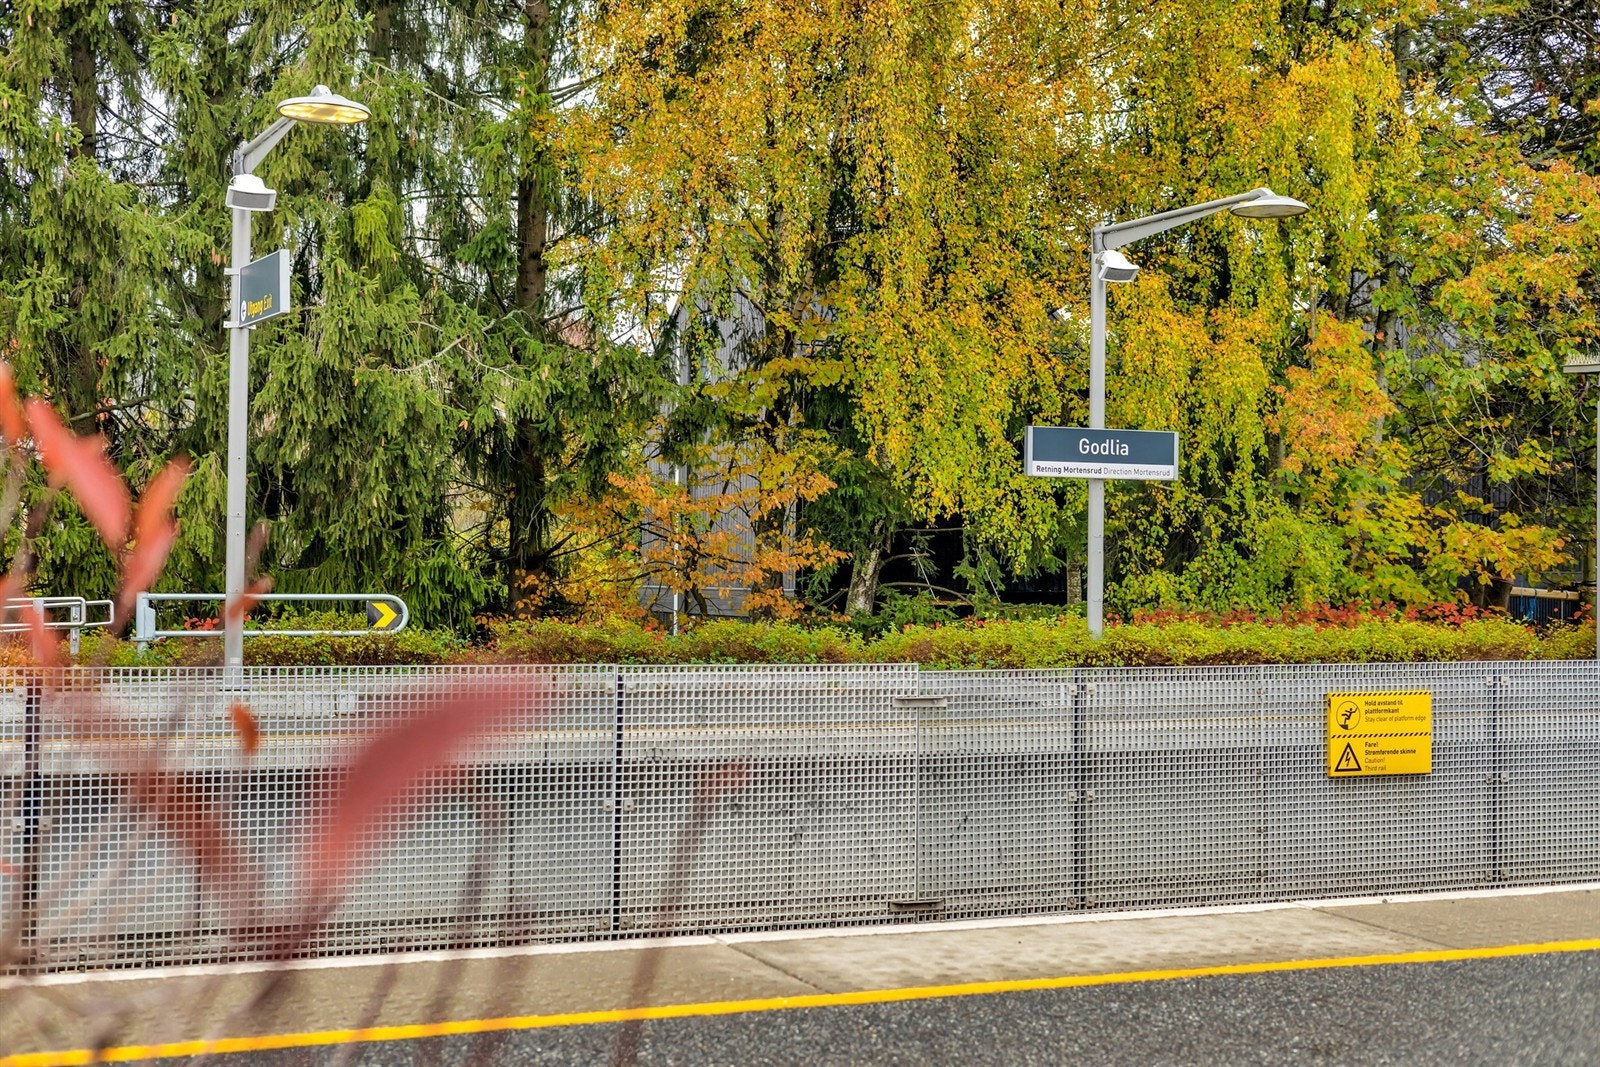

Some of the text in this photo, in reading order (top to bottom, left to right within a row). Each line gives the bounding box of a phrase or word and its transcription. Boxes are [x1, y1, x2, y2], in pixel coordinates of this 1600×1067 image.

[1079, 437, 1129, 456] Godlia
[1036, 465, 1171, 477] Retning Mortensrud Direction Mortensrud
